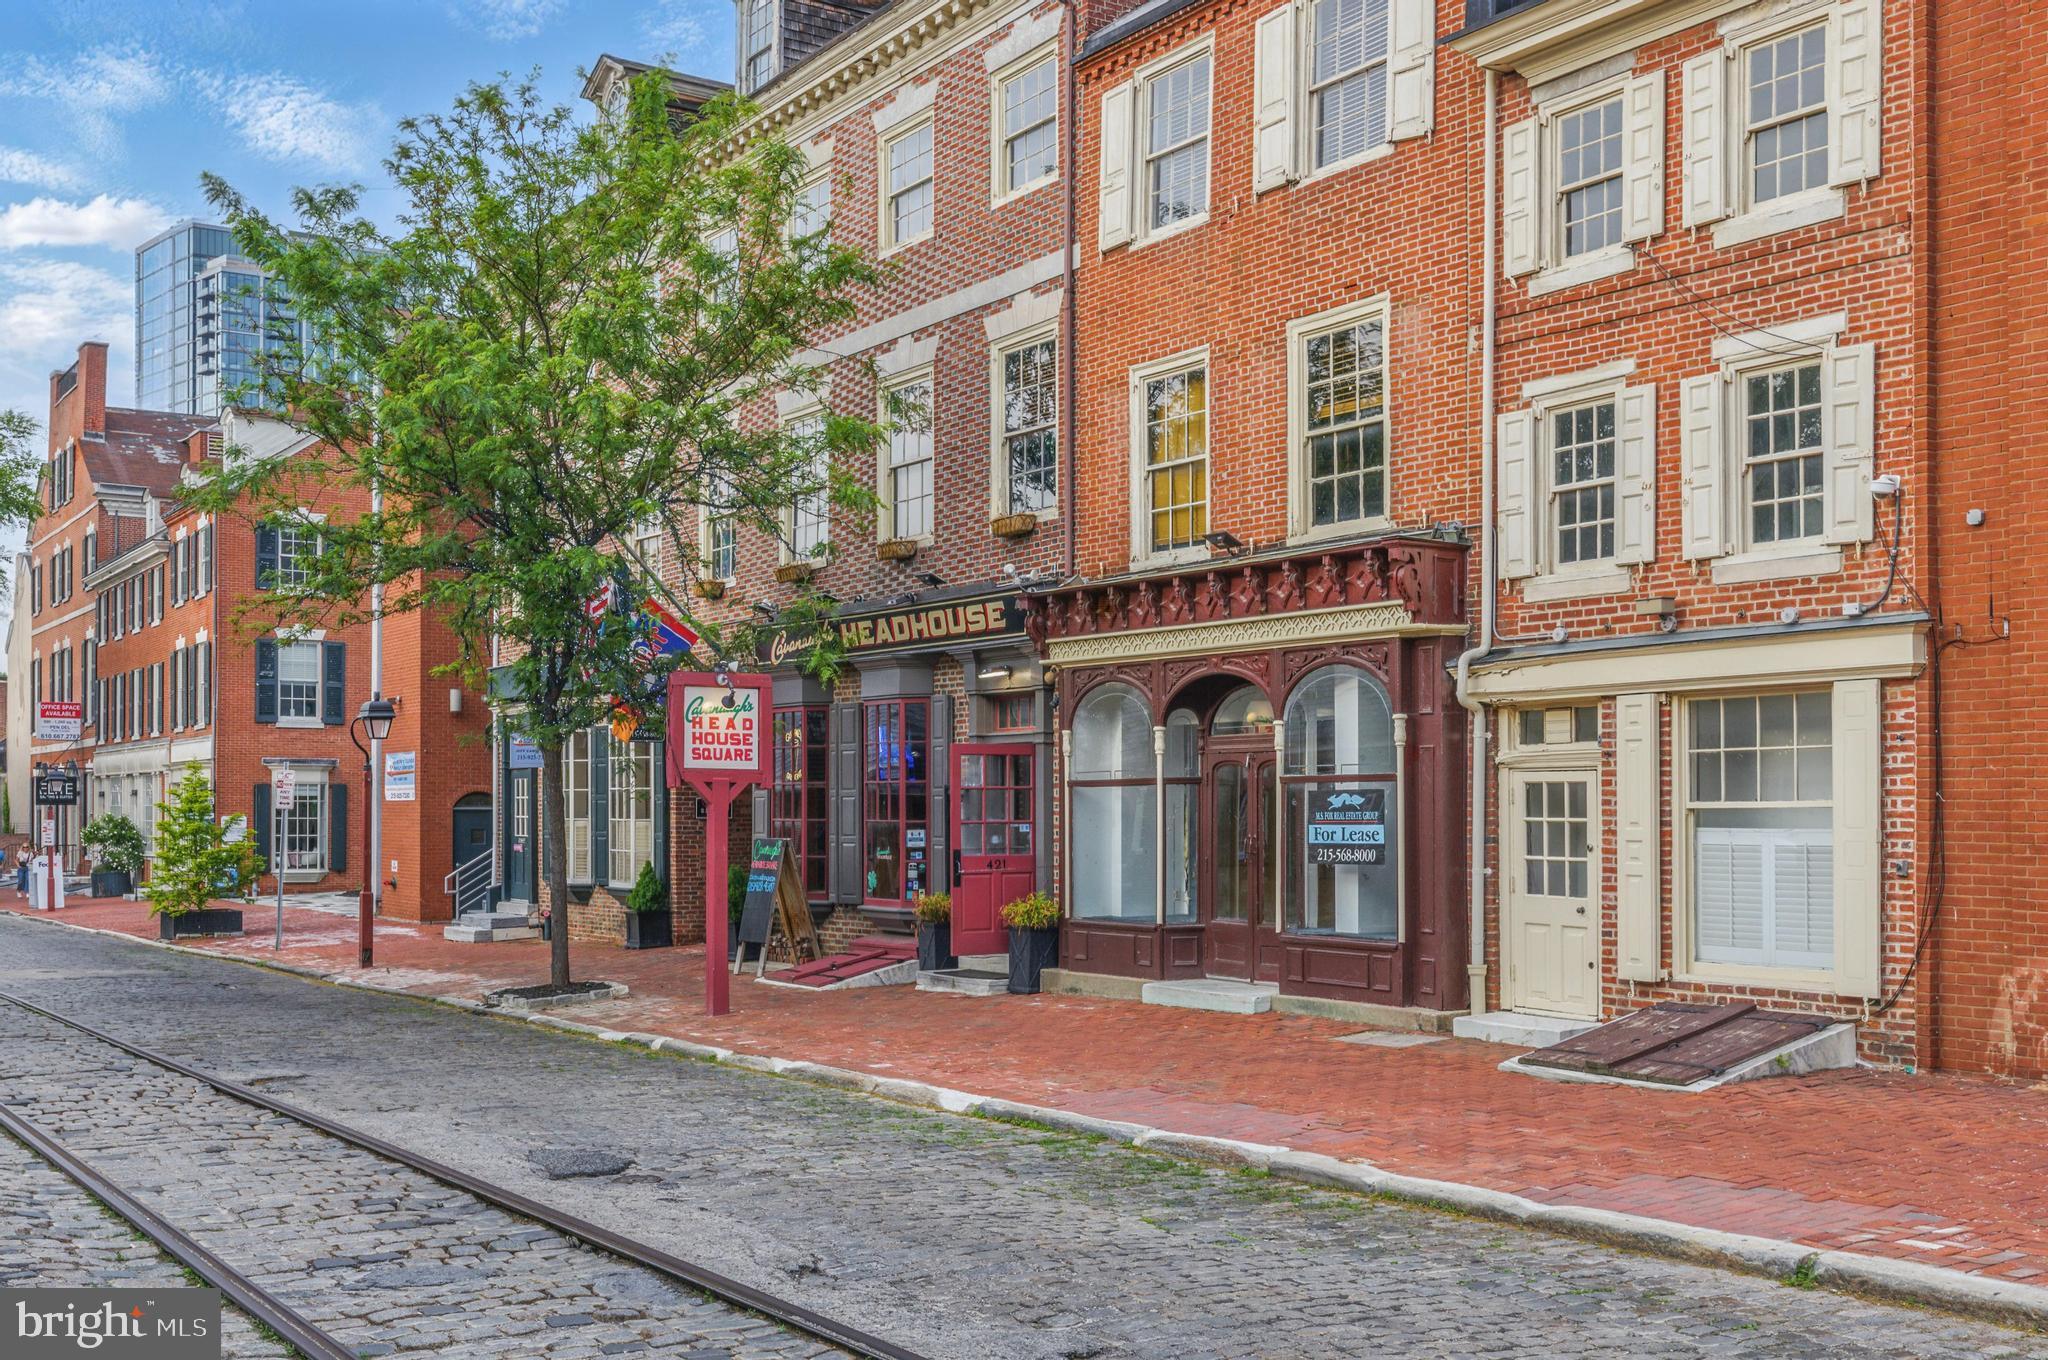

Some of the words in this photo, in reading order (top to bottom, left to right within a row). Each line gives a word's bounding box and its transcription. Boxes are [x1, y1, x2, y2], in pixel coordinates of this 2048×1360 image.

[841, 602, 1007, 647] HEADHOUSE
[691, 716, 754, 730] HEAD
[691, 732, 754, 746] HOUSE
[691, 747, 754, 761] SQUARE
[1324, 811, 1334, 820] FOX
[1334, 811, 1345, 820] REAL
[1345, 811, 1362, 820] ESTATE
[1362, 811, 1378, 820] GROUP
[1313, 826, 1337, 842] For
[1341, 826, 1380, 842] Lease
[1317, 848, 1376, 862] 215-568-8000
[986, 859, 1006, 870] 421
